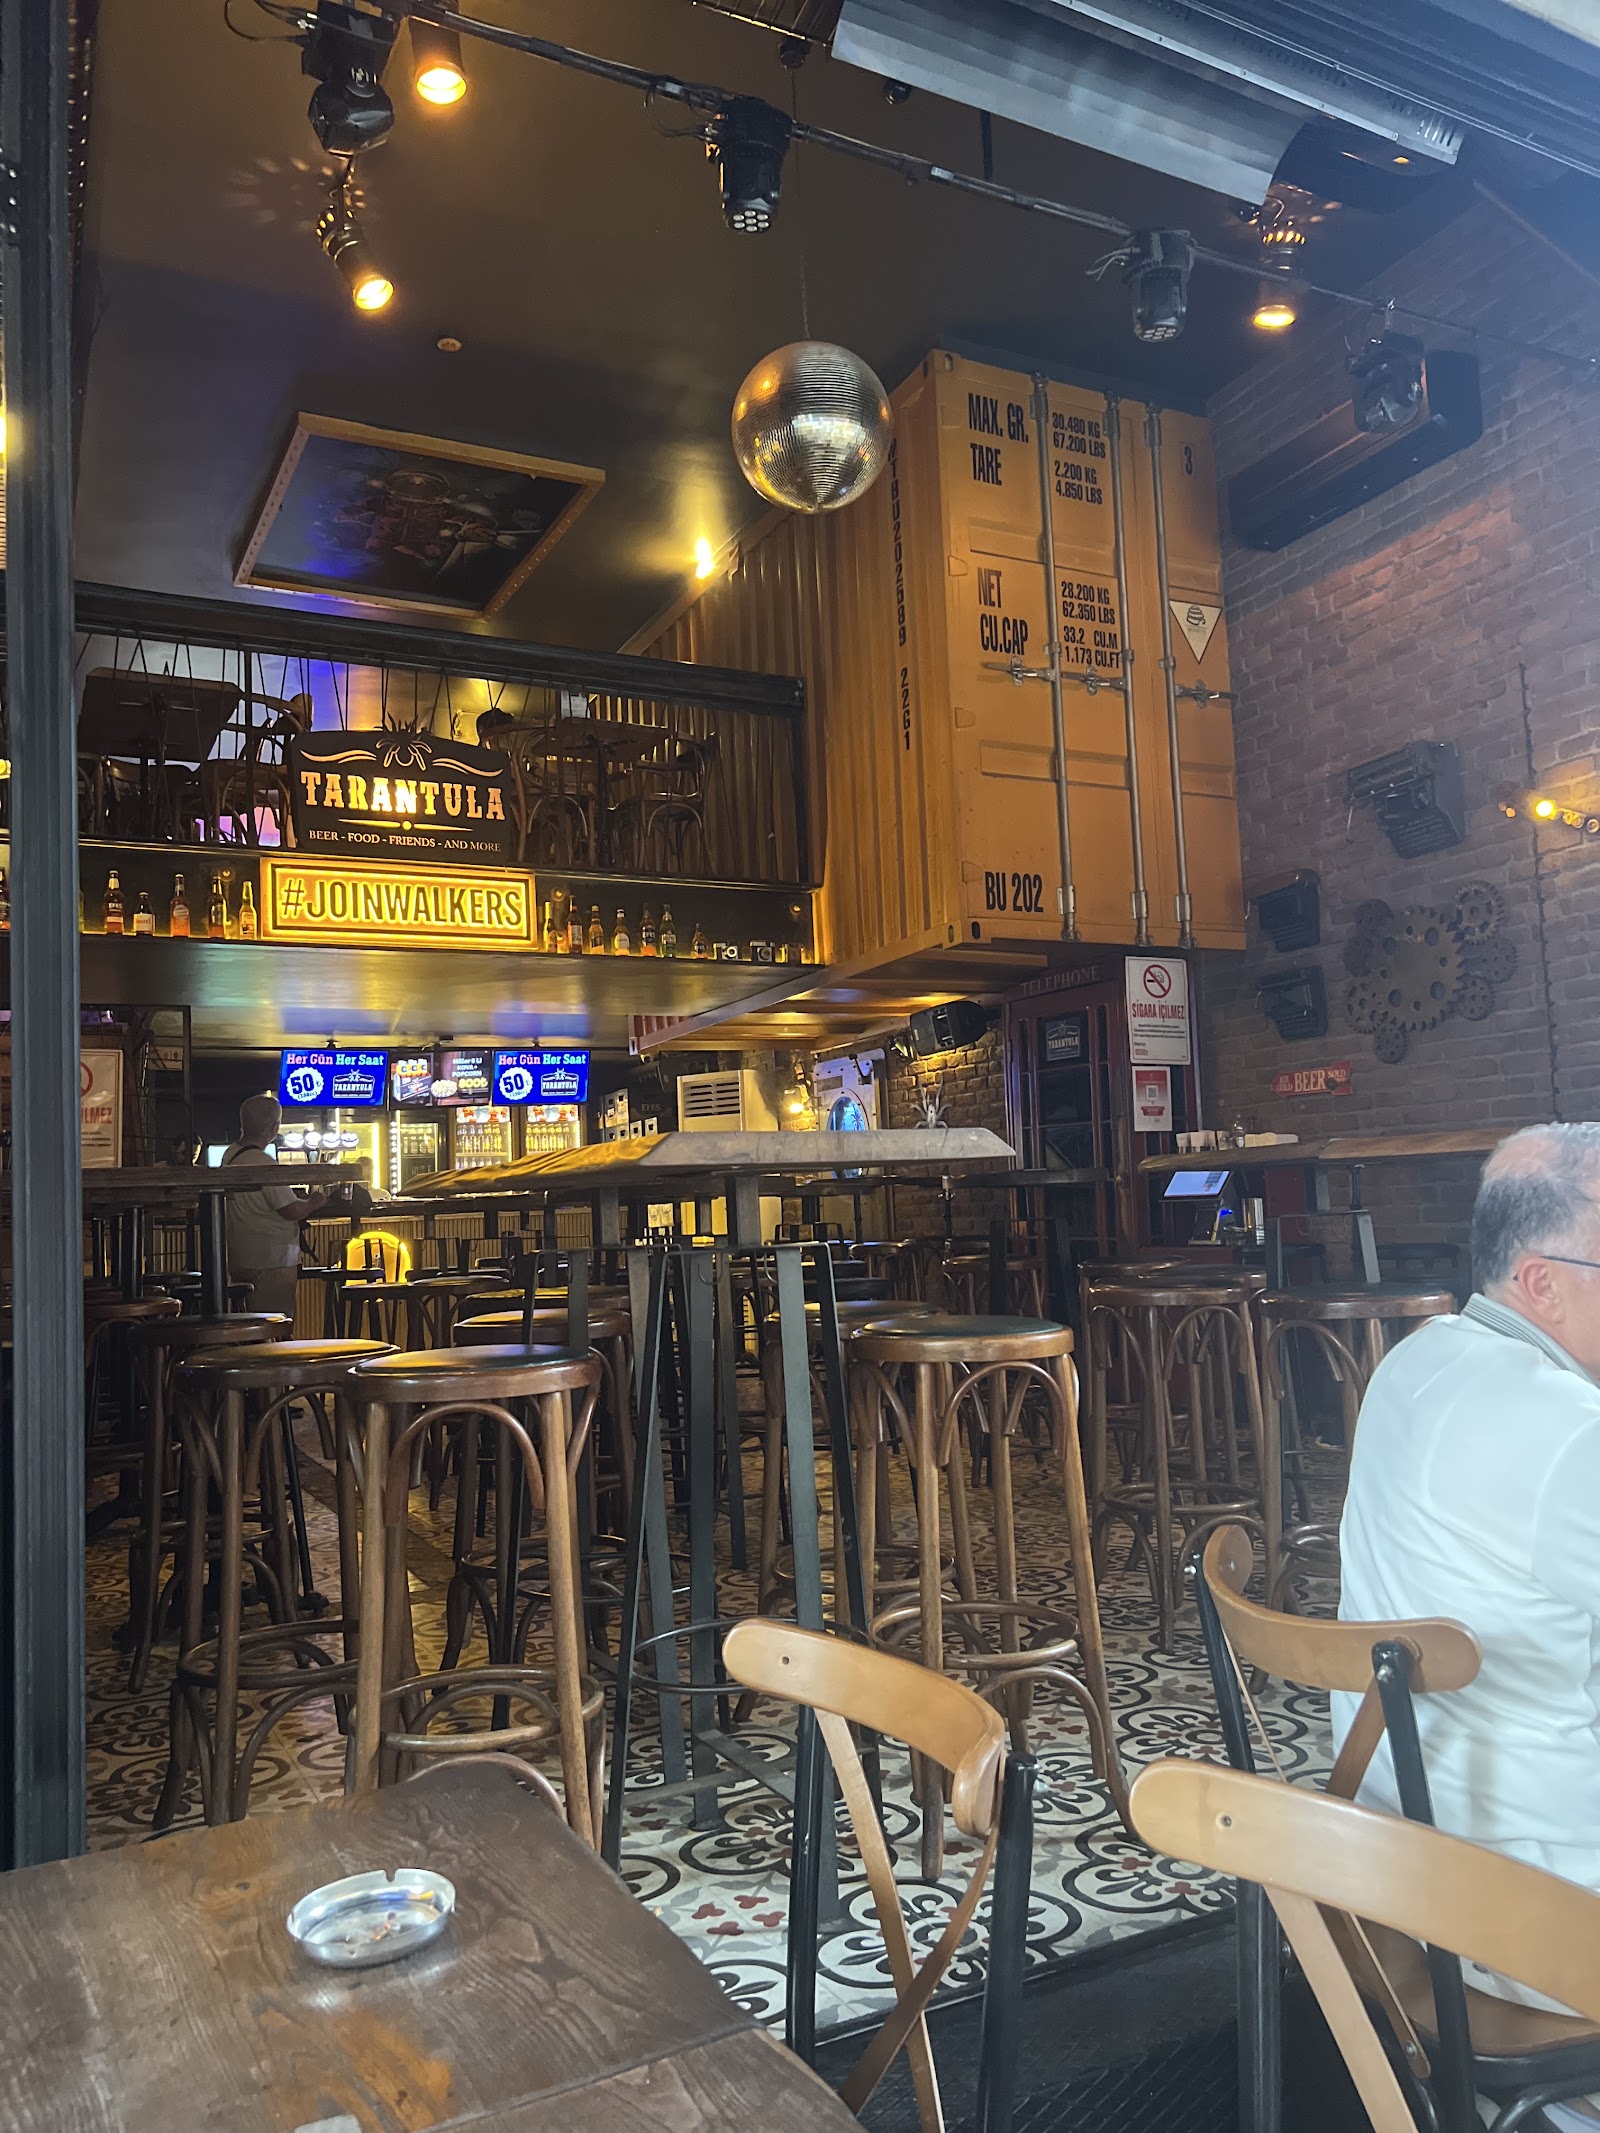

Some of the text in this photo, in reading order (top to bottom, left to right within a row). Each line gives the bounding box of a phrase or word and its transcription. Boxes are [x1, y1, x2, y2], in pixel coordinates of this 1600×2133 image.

[968, 392, 1029, 443] MAX. GR.
[1052, 412, 1101, 438] 30.480 KG
[1053, 431, 1106, 459] 67.200 LBS
[970, 443, 1003, 487] TARE
[1054, 460, 1097, 485] 2.200 KG
[1184, 445, 1193, 476] 3
[1055, 479, 1103, 506] 4.850 LBS
[977, 567, 1002, 609] NET
[1061, 580, 1110, 605] 28.200 KG
[1062, 600, 1115, 626] 62.350 LBS
[980, 613, 1028, 656] CU.CAP
[1063, 627, 1118, 650] 33.2 CU.M
[1065, 645, 1092, 666] 1.173
[900, 667, 910, 751] 22G1
[301, 771, 506, 821] TARANTULA
[309, 829, 501, 853] BEER FOOD FRIENDS AND MORE
[281, 877, 522, 928] #JOINWALKERS
[985, 871, 1044, 913] BU 202
[1021, 965, 1099, 997] TELEPHONE
[1132, 1000, 1157, 1018] SİGARA
[286, 1053, 384, 1066] Her Gün Her Saat
[498, 1053, 587, 1065] Her Gün Her Saat
[290, 1073, 315, 1095] 50
[334, 1083, 372, 1091] TARANTULA
[503, 1073, 524, 1094] 50
[542, 1081, 577, 1089] TARANTULA
[1294, 1070, 1326, 1093] BEER
